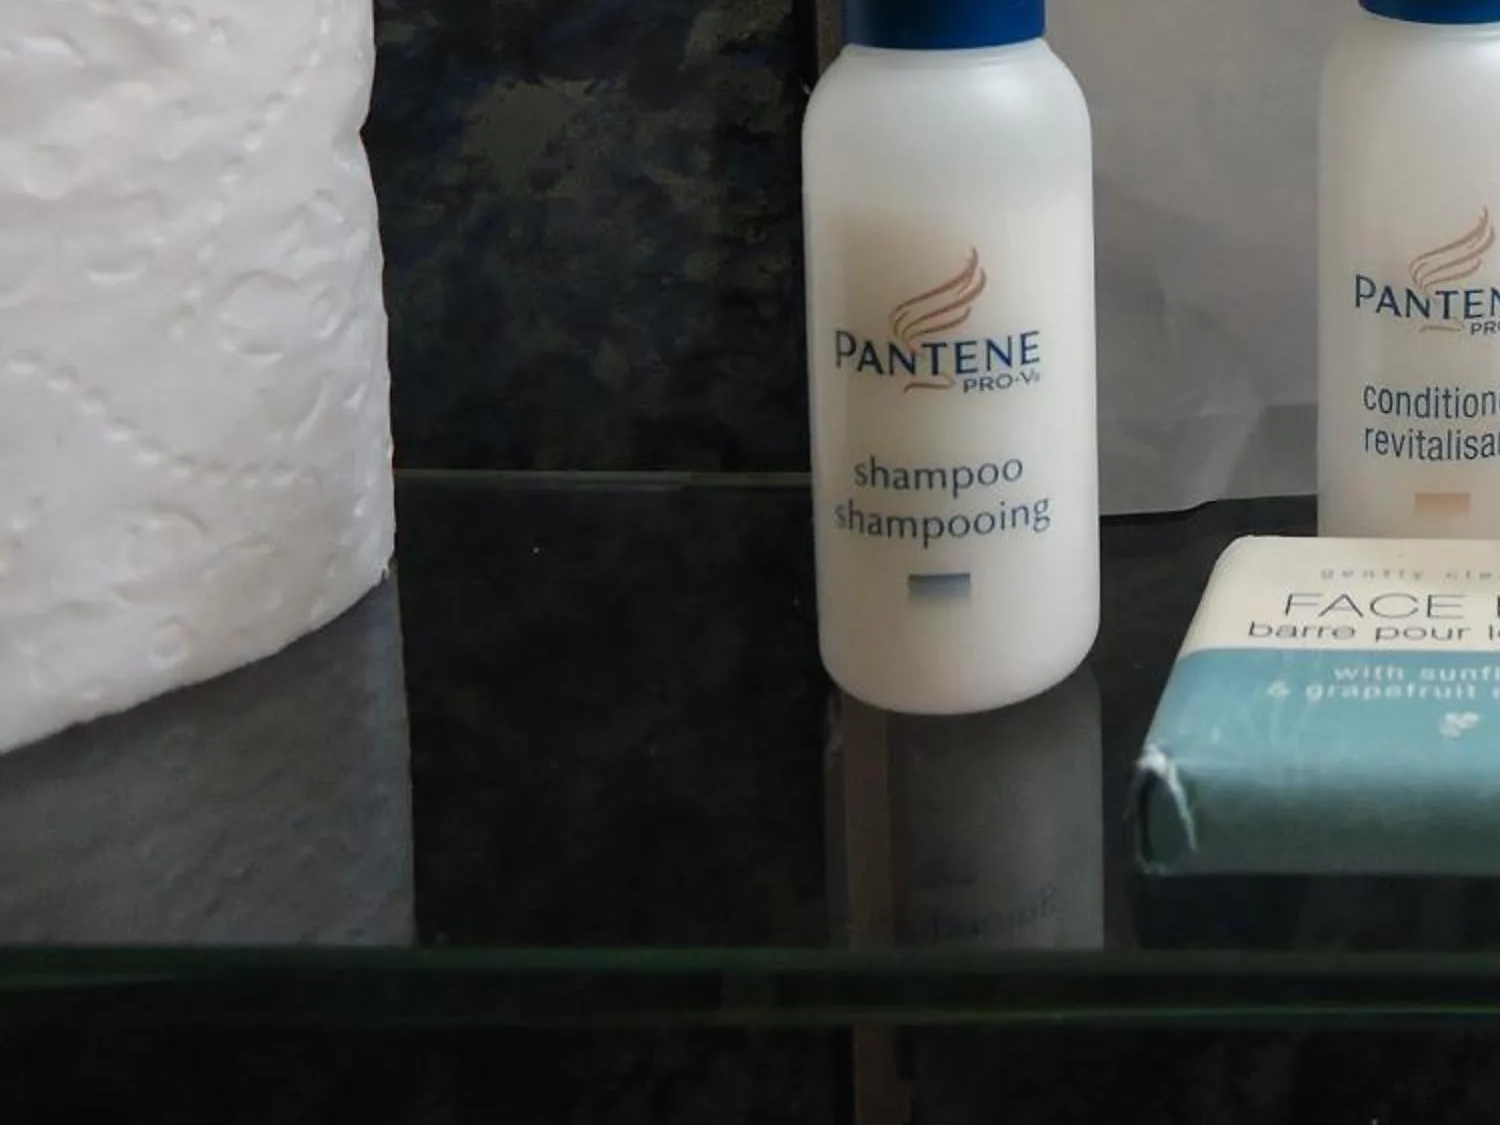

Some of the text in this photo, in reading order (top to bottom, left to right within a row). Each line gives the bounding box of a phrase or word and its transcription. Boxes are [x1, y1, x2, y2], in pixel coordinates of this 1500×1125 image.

[835, 329, 1041, 376] PANTENE
[852, 456, 1024, 499] shampoo
[833, 497, 1053, 549] shampooing
[1284, 592, 1466, 619] FACE
[1248, 621, 1357, 639] barre
[1374, 625, 1472, 643] pour
[1332, 666, 1405, 682] with
[1305, 681, 1478, 704] grapefruit
